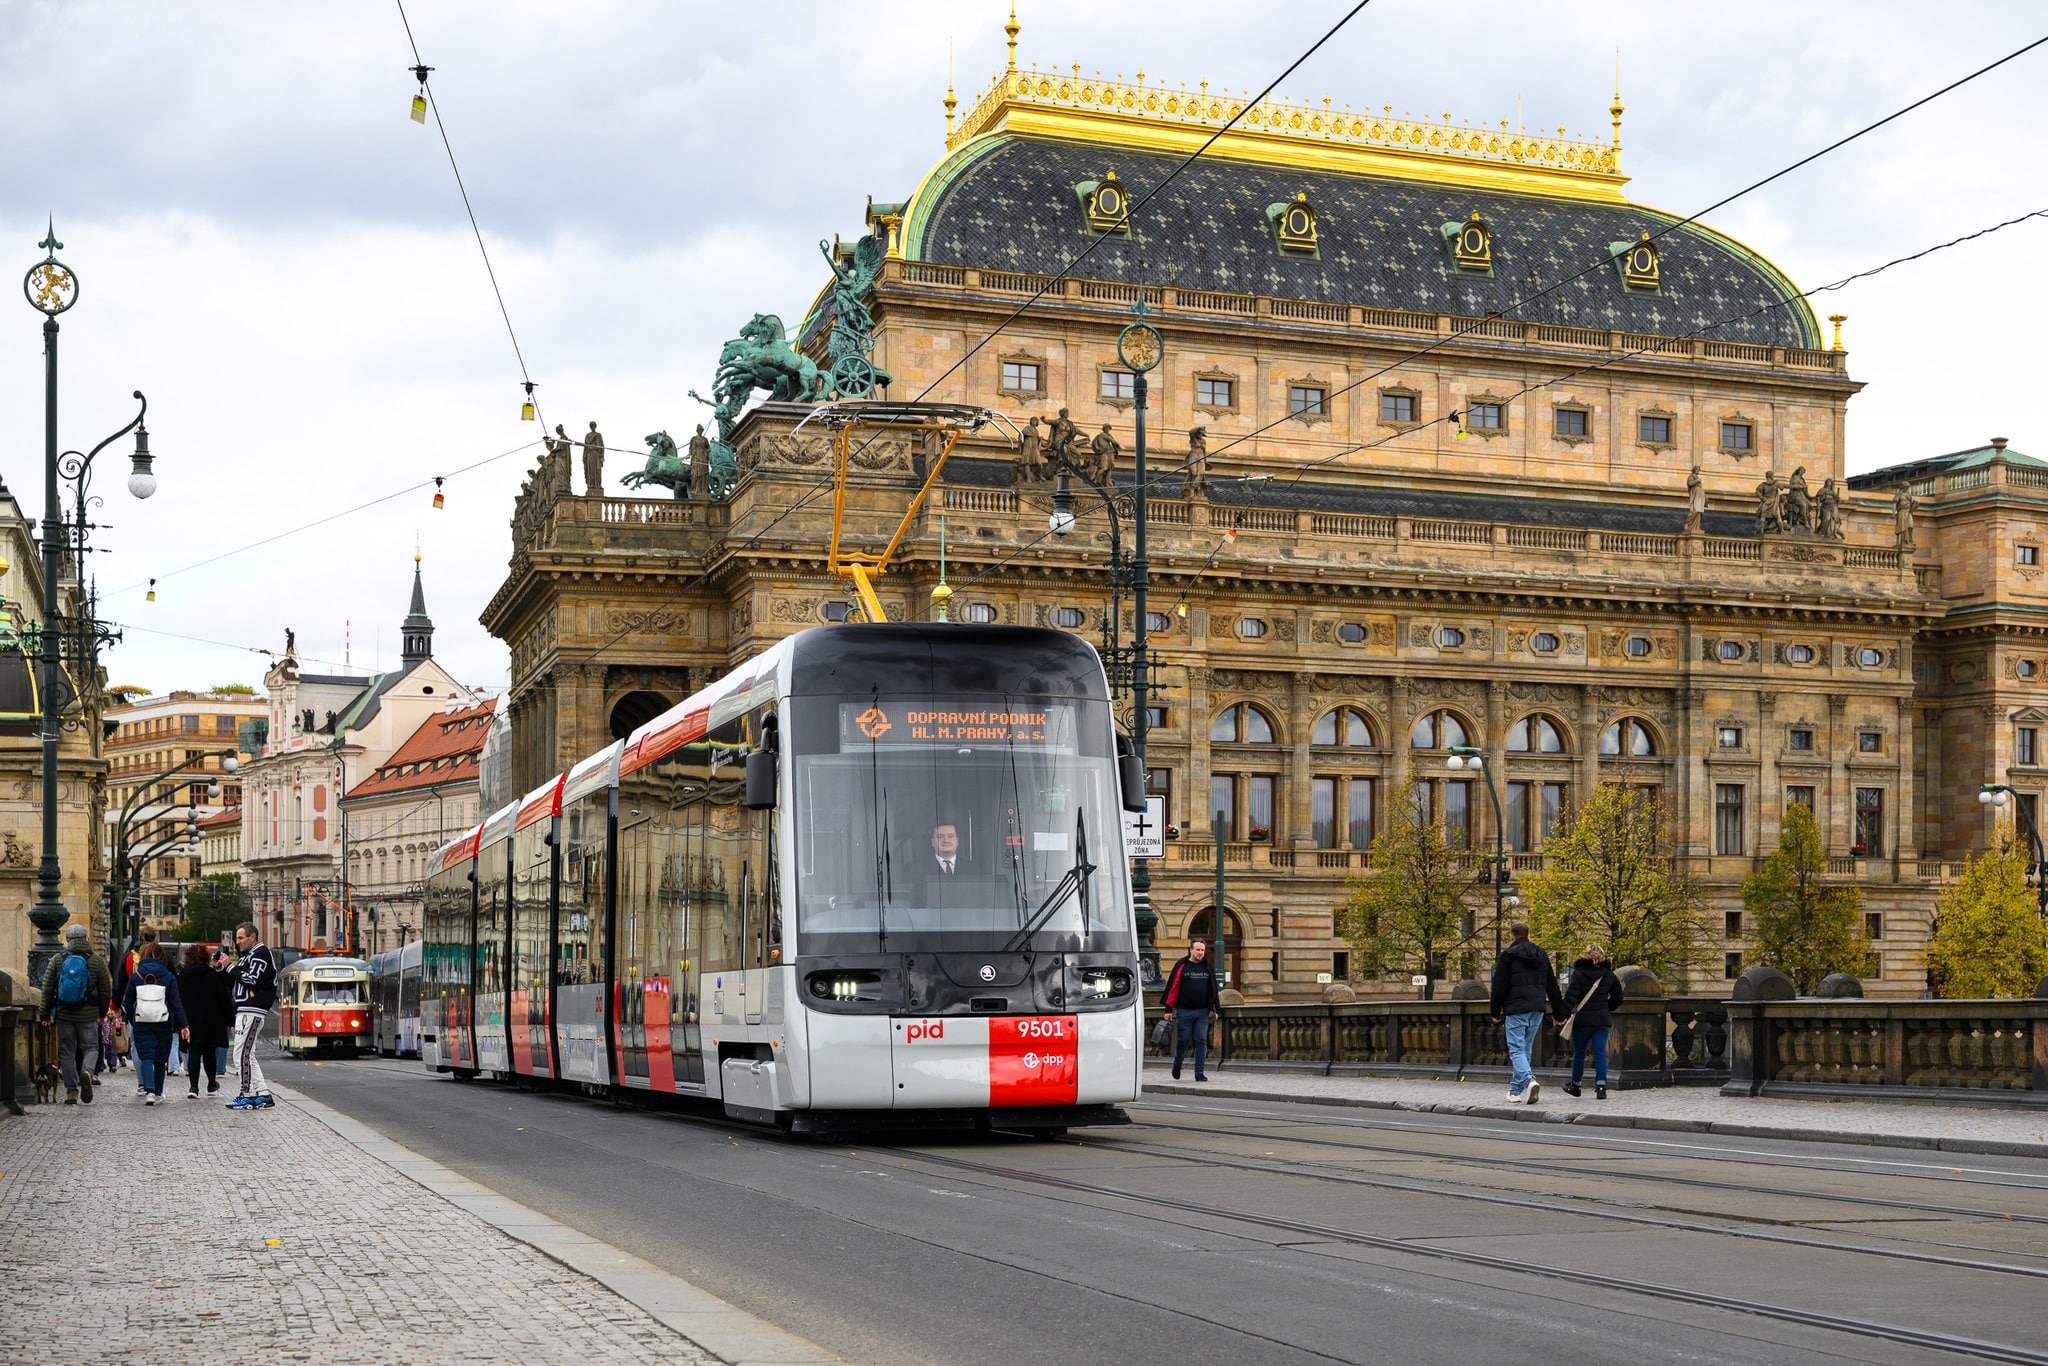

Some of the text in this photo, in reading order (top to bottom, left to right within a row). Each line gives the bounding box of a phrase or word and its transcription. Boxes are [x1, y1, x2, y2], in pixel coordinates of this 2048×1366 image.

[908, 710, 1046, 725] DOPRAVNÍ PODNIK
[912, 727, 935, 739] HL.
[938, 727, 954, 739] M.
[1017, 731, 1029, 740] a.
[1032, 731, 1045, 740] s.
[907, 1019, 944, 1043] pid
[1018, 1021, 1064, 1038] 9501
[1042, 1054, 1064, 1066] dpp
